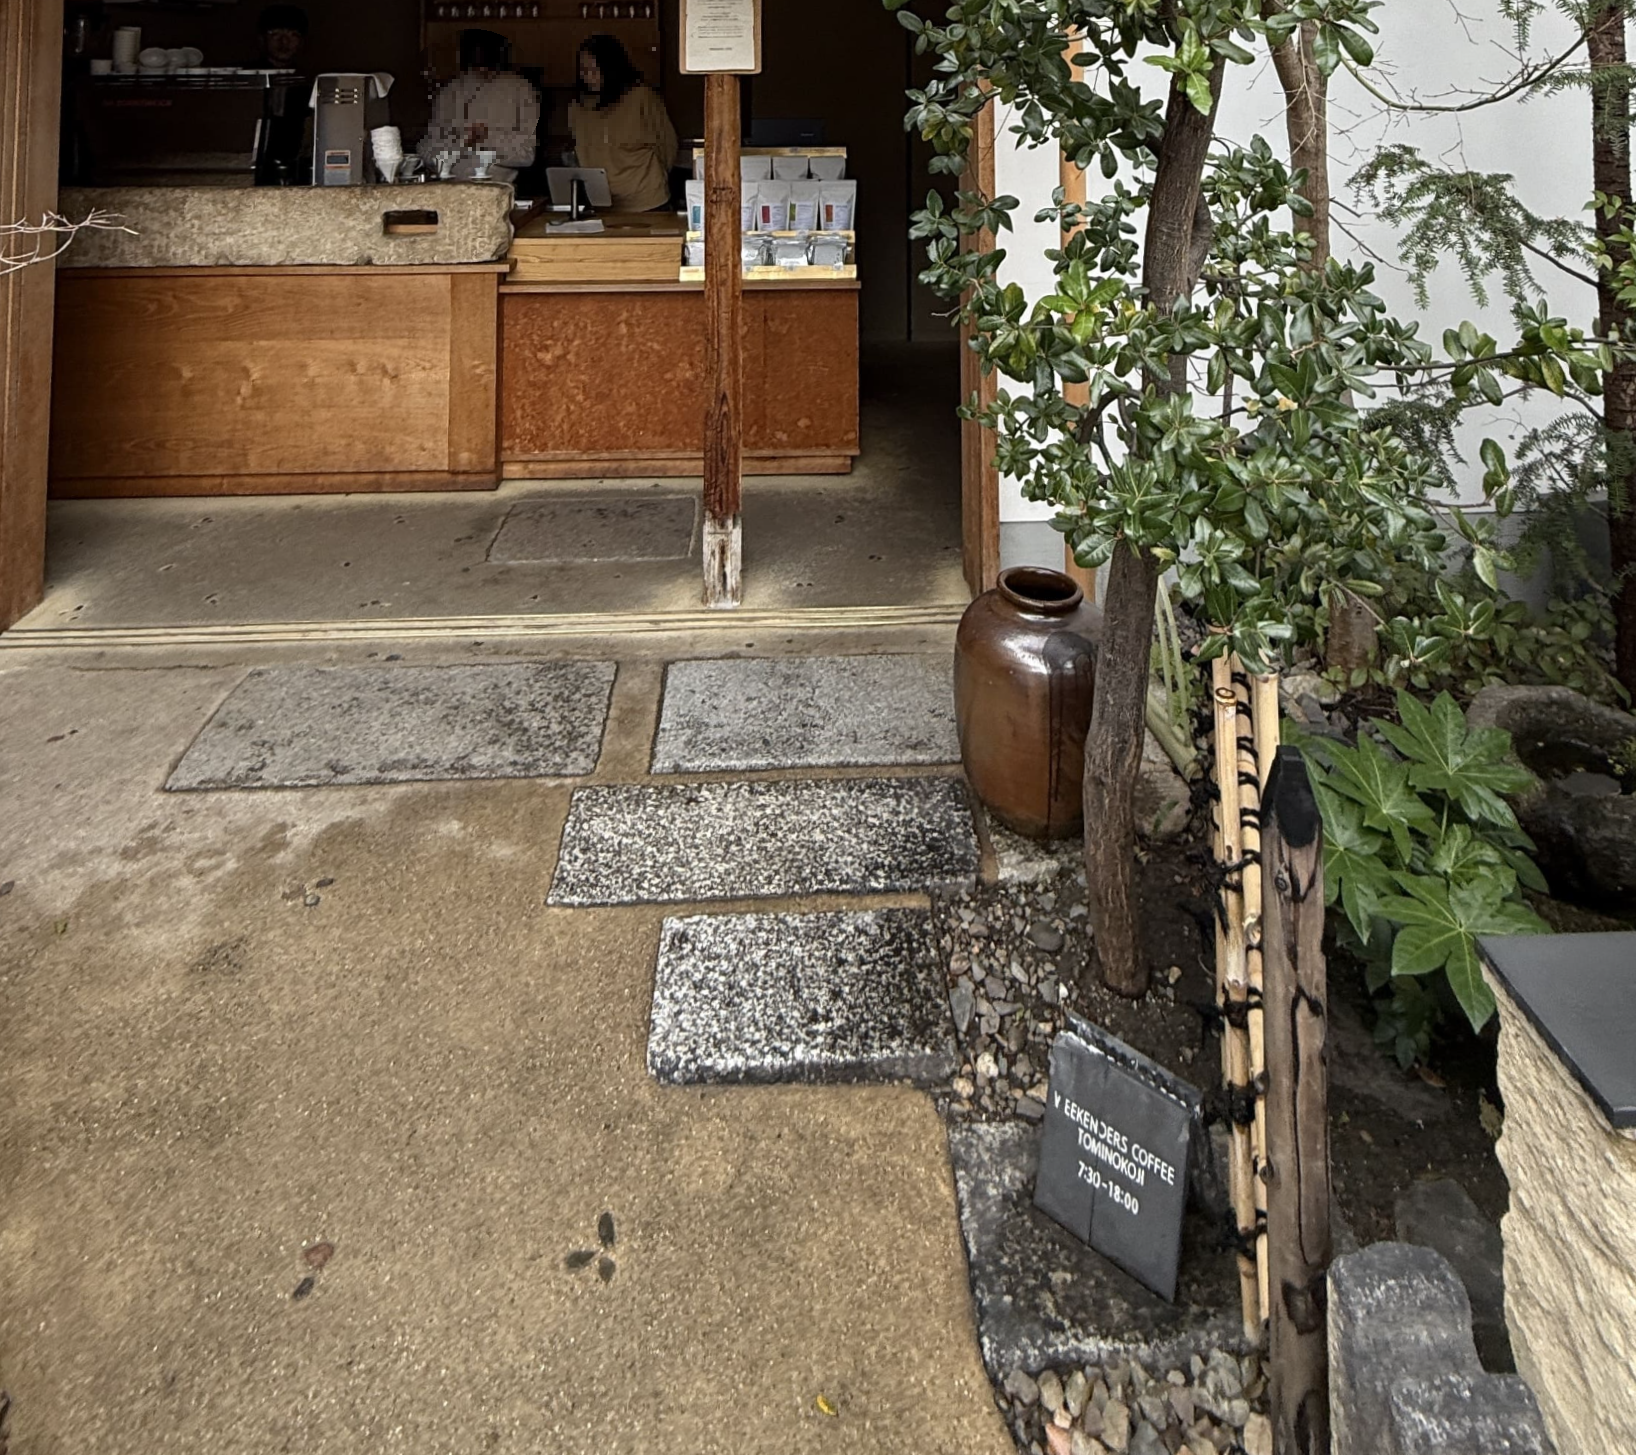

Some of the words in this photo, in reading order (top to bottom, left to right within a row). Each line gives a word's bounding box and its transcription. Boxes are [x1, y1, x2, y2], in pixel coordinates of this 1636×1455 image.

[1077, 1127, 1145, 1187] TOMINOKOJI
[1131, 1143, 1175, 1186] COFFEE
[1077, 1160, 1139, 1215] 7:30-18:00
